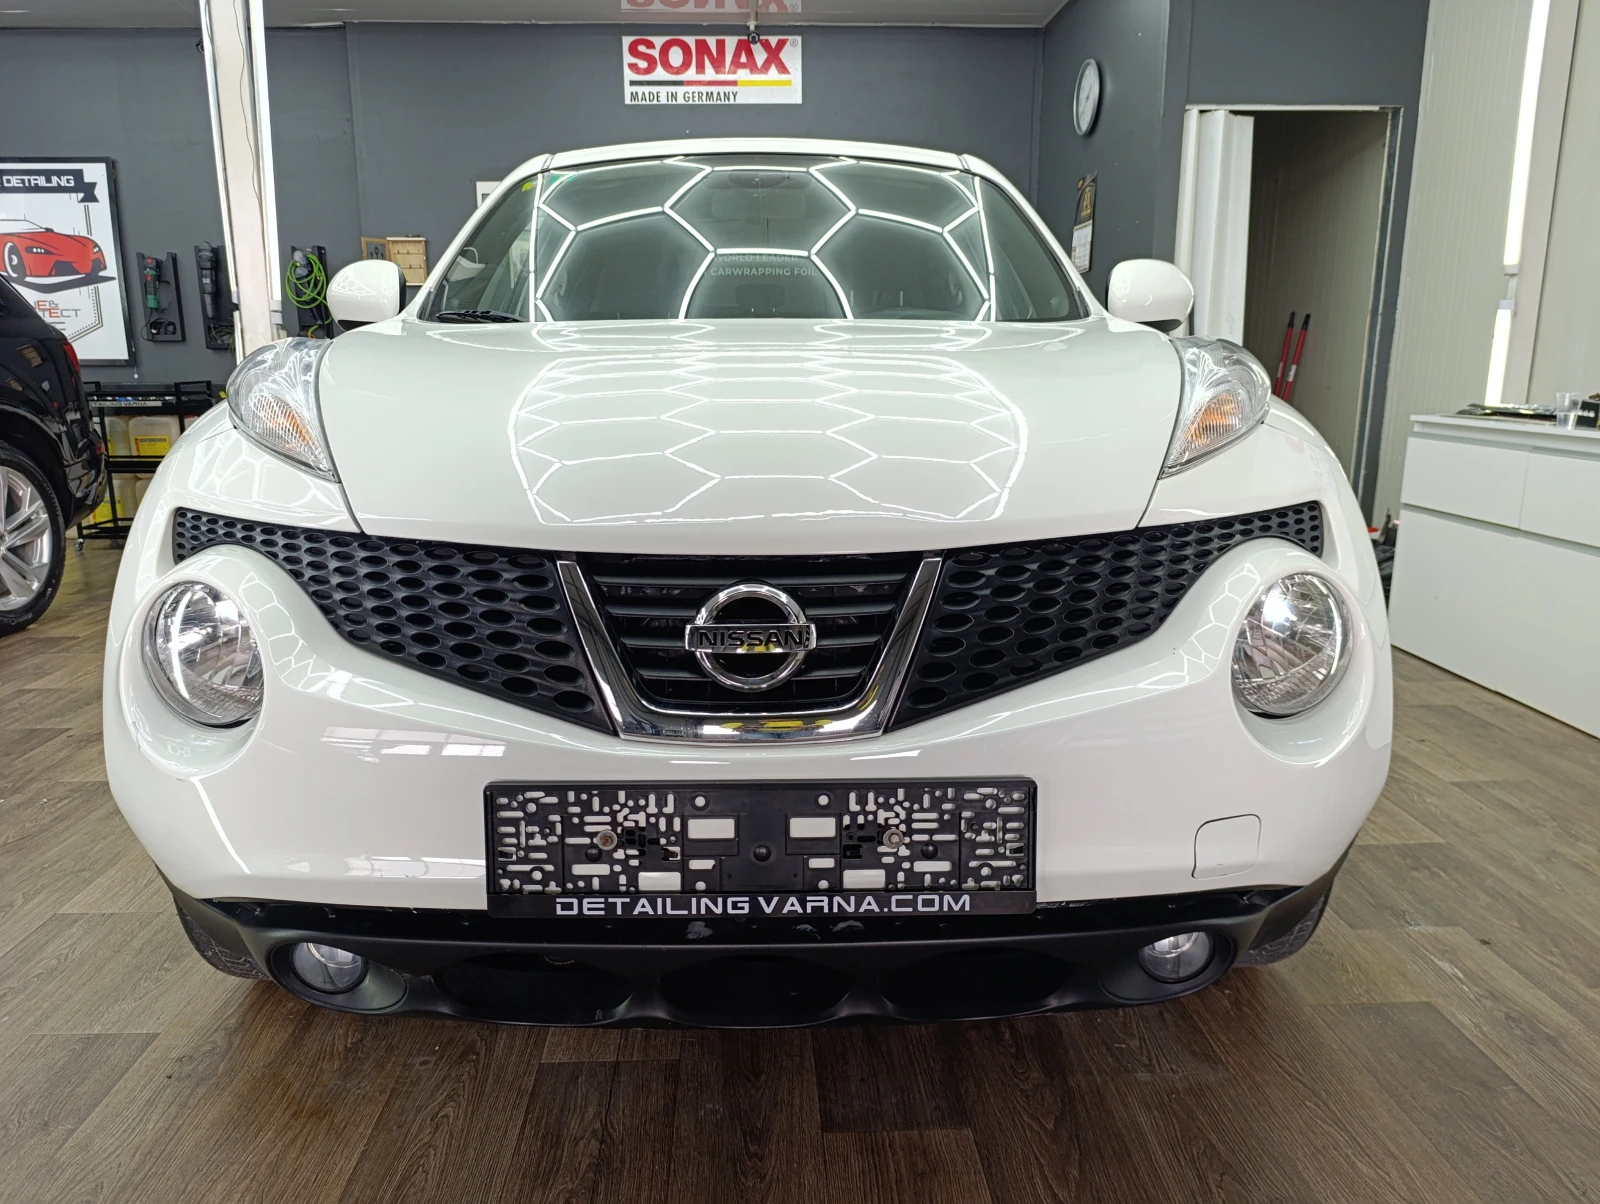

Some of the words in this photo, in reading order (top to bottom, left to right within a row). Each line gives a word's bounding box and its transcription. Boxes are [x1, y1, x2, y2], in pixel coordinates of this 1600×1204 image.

[627, 38, 792, 76] SONAX
[630, 91, 661, 103] MADE
[666, 91, 678, 103] IN
[683, 91, 738, 103] GERMANY
[3, 175, 75, 187] DETAILING
[710, 267, 791, 276] CARWRAPPING
[699, 630, 801, 647] NISSAN
